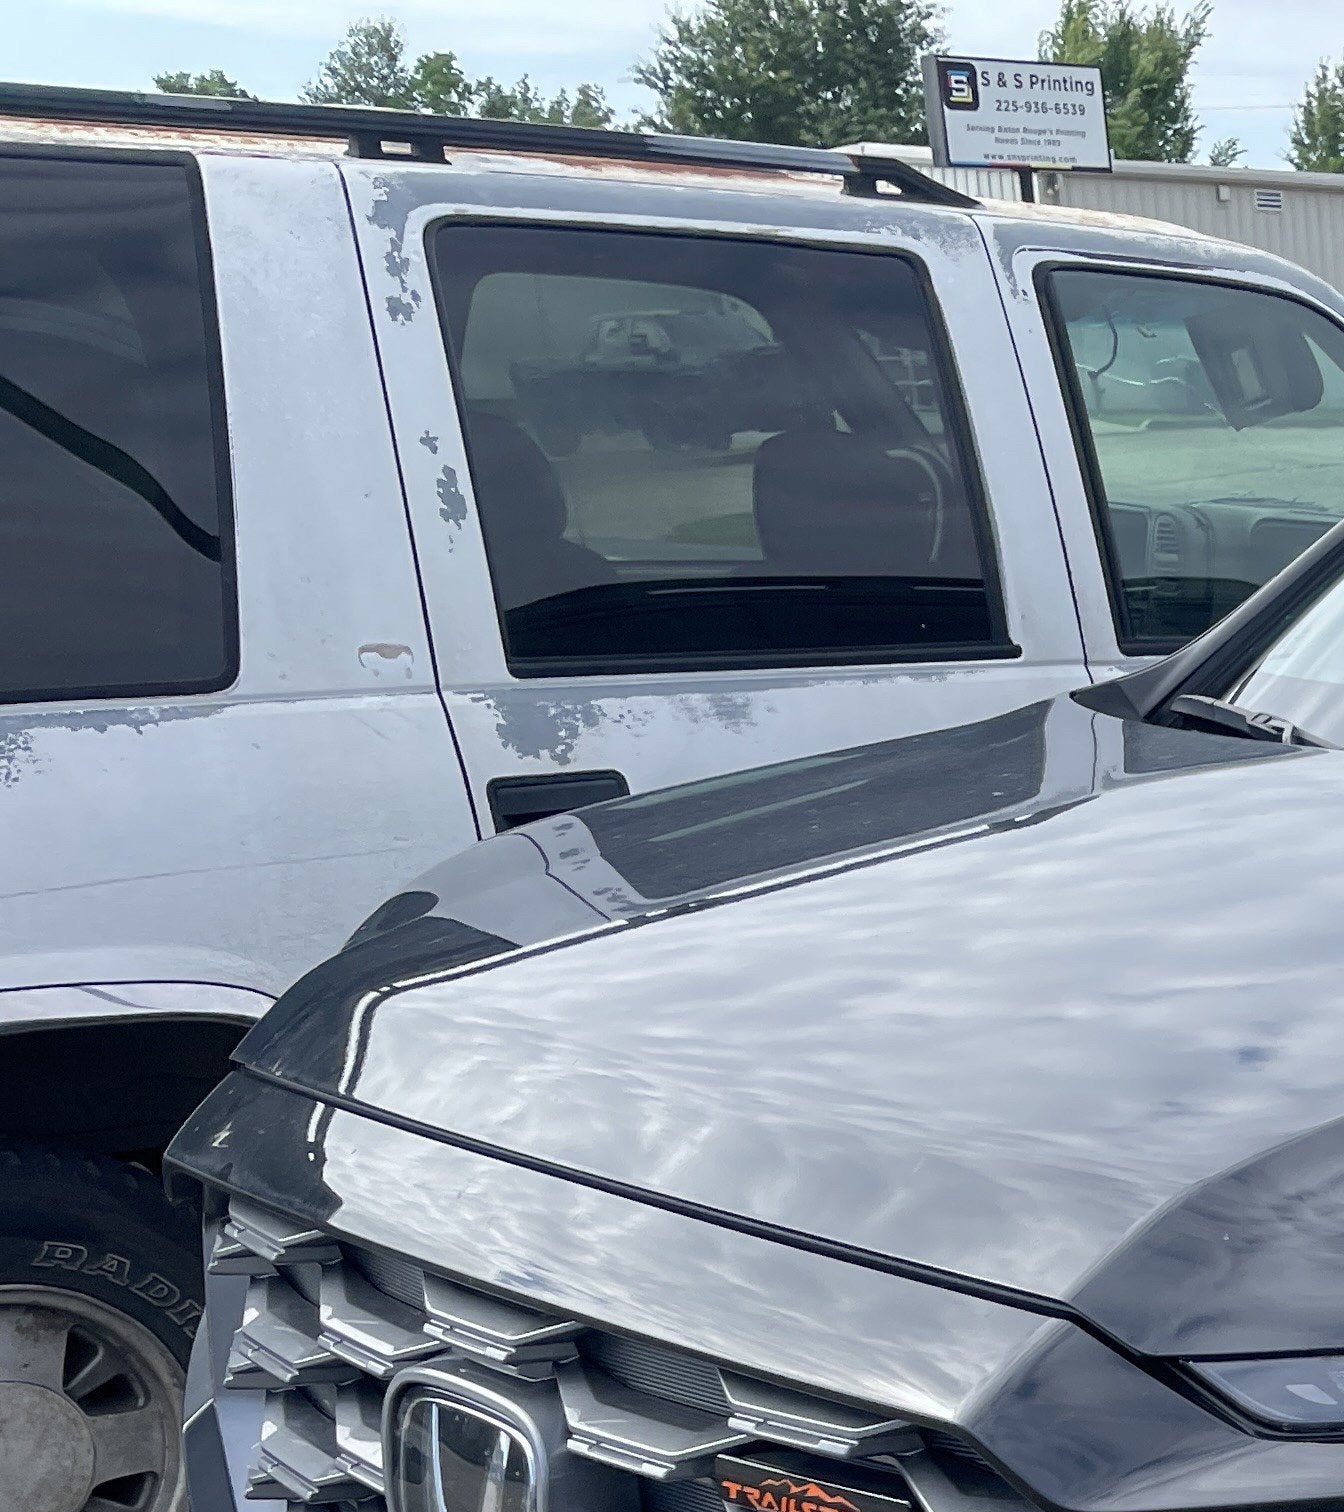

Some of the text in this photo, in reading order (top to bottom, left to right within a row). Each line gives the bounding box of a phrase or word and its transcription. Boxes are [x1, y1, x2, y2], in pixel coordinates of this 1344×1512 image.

[981, 71, 1095, 96] S & S Printing
[995, 99, 1086, 116] 225-936-6539
[31, 1240, 203, 1339] RADI
